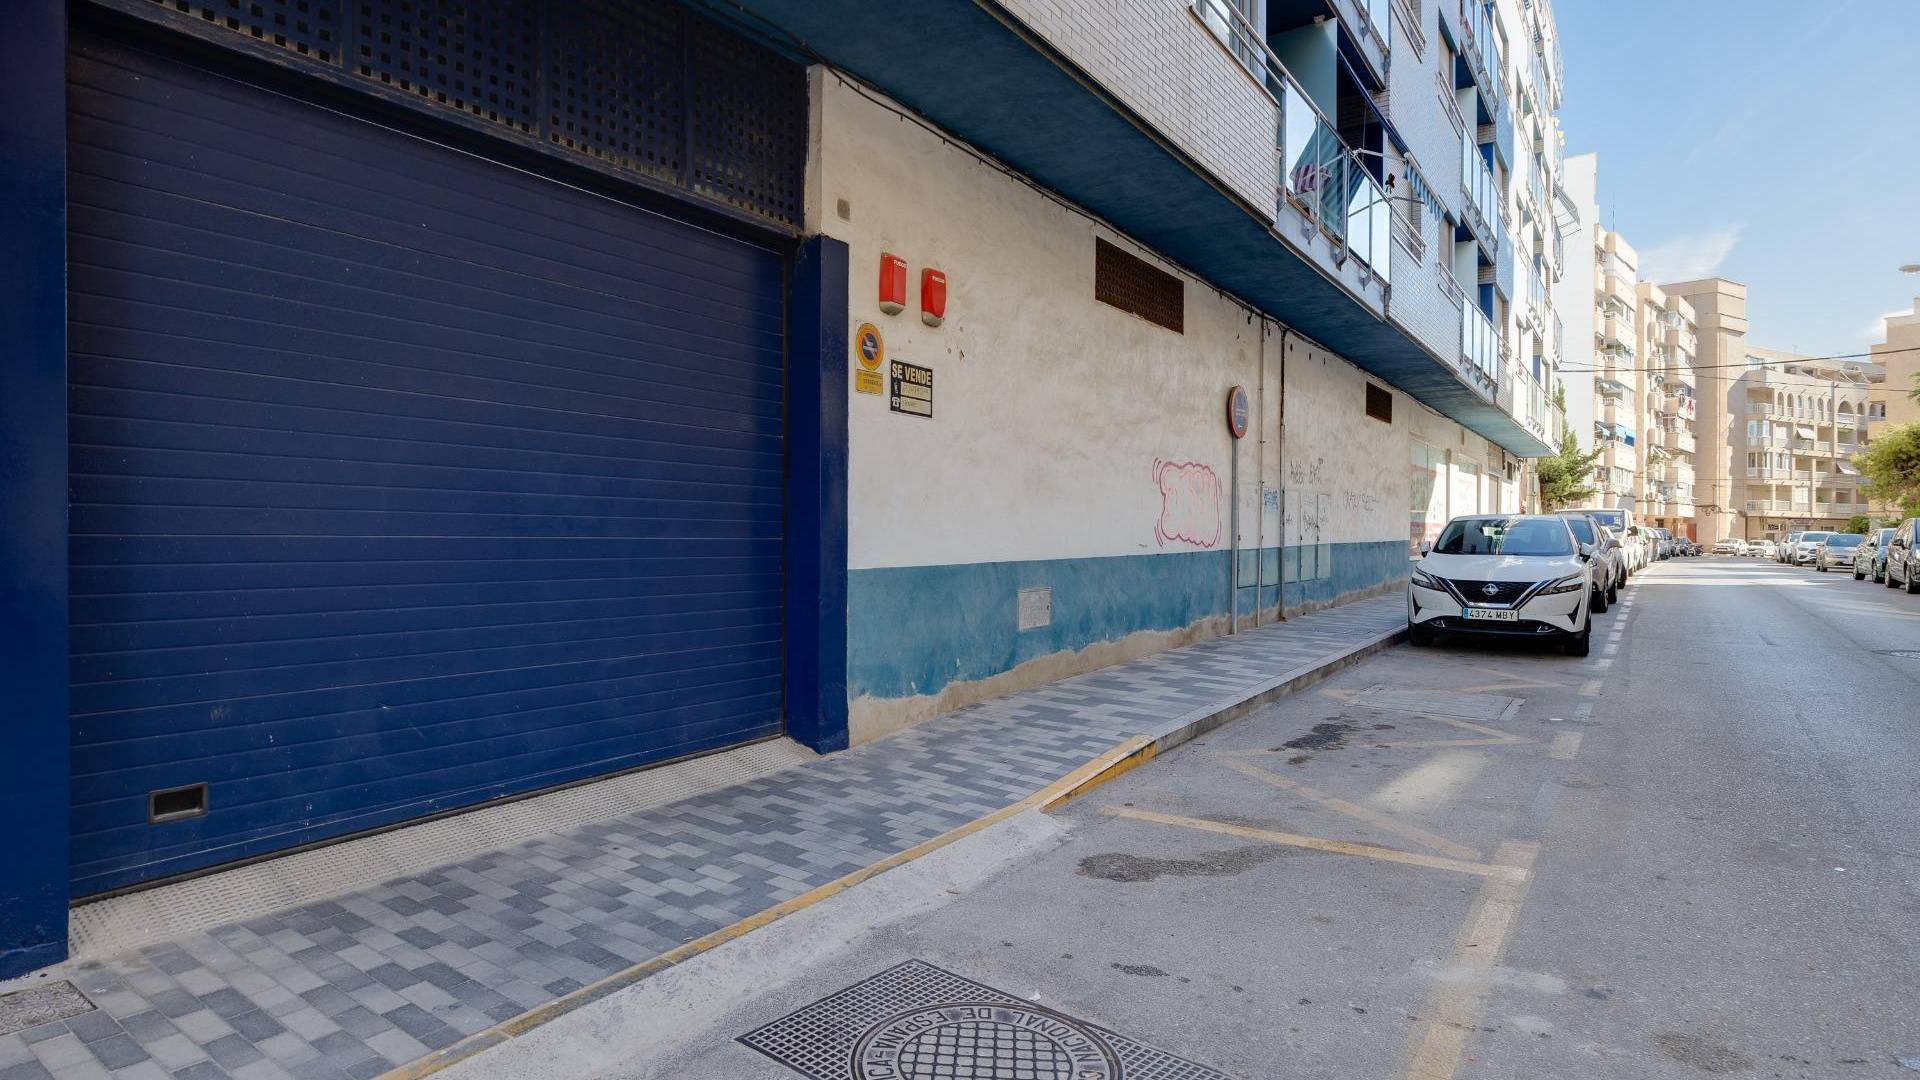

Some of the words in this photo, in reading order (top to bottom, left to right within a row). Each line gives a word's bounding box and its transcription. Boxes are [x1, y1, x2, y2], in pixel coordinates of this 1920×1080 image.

[892, 363, 903, 379] SE
[904, 366, 932, 385] VENDE
[1469, 609, 1493, 618] 4374
[1495, 611, 1515, 620] MBY
[960, 1007, 992, 1020] DE
[1012, 1010, 1102, 1062] NACIONAL
